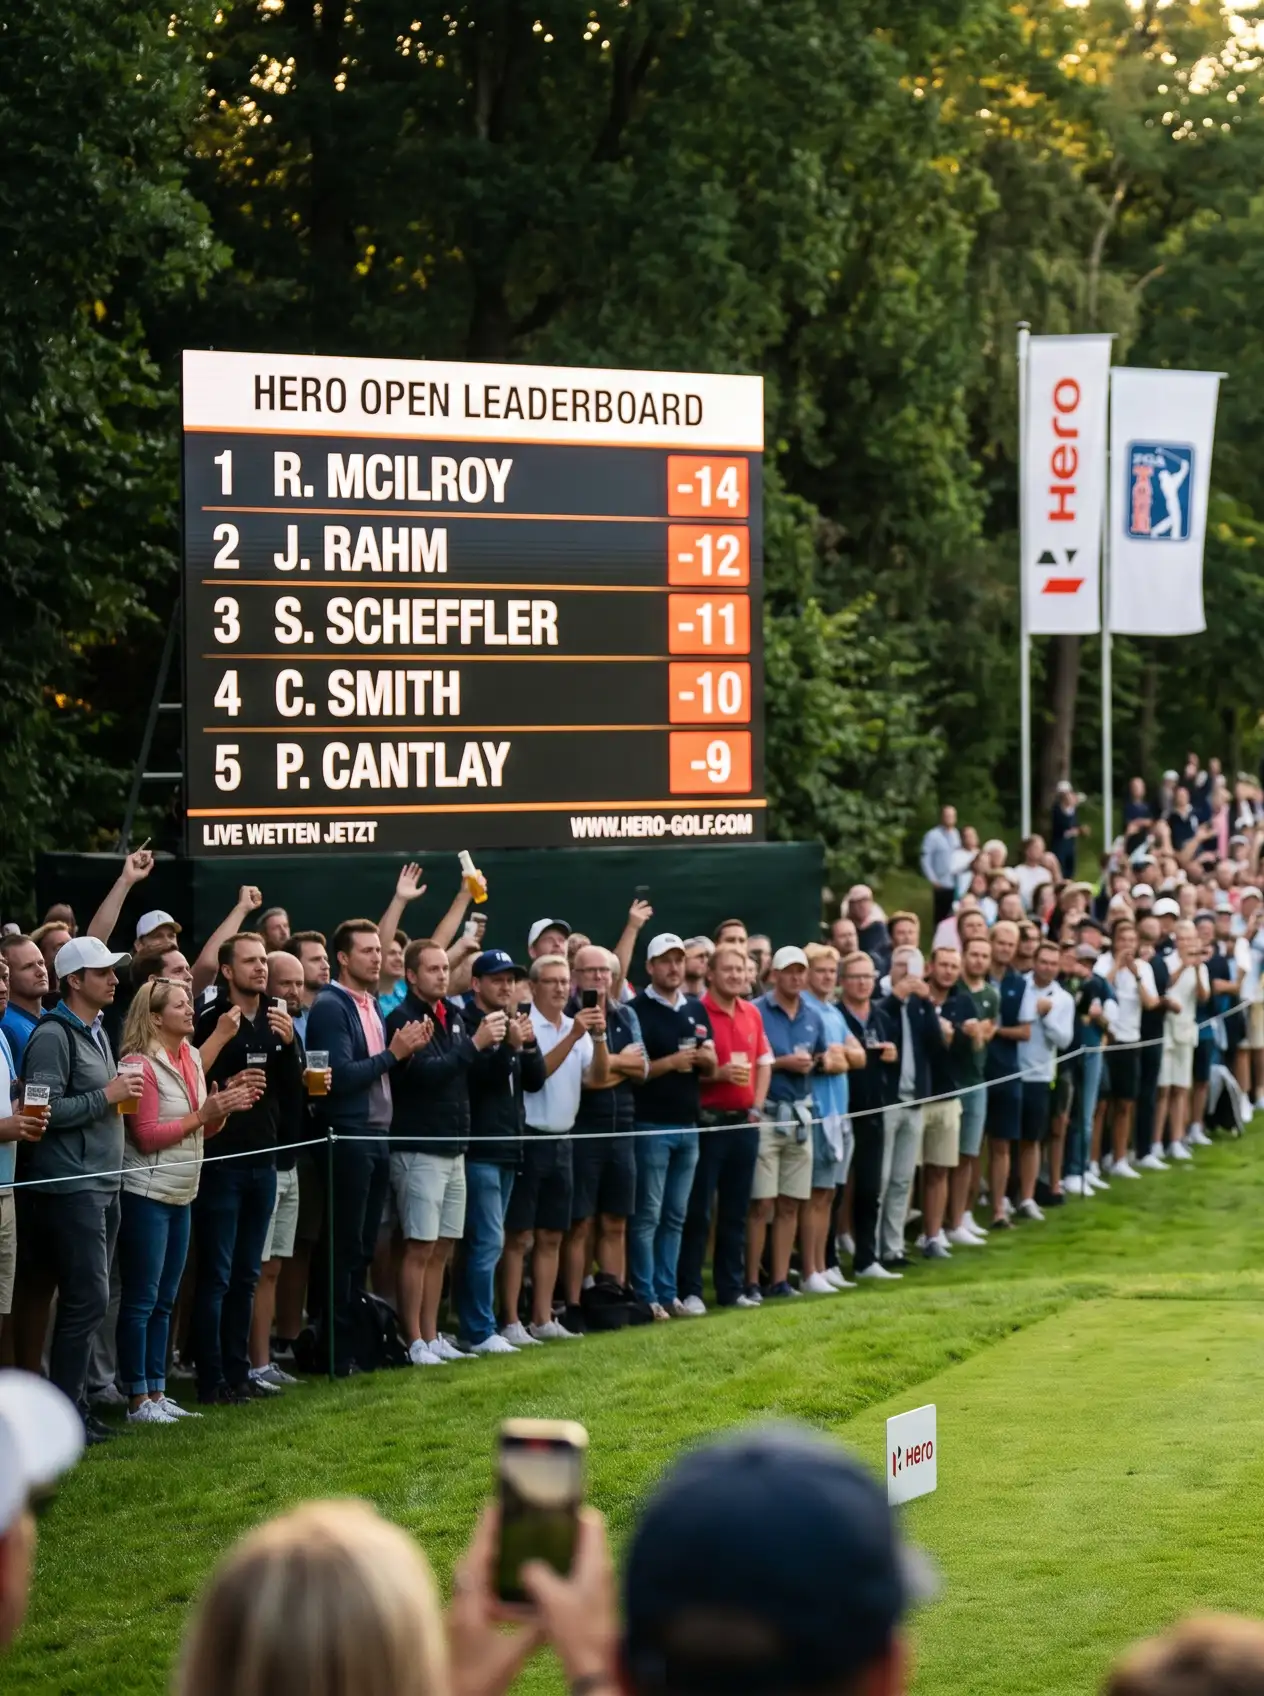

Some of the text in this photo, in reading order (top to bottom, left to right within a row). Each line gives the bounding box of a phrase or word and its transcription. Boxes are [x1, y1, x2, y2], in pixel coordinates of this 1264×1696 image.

[254, 375, 703, 426] HERO OPEN LEADERBOARD
[1048, 377, 1081, 522] Hero
[213, 450, 741, 508] 1 R. MCILROY -14
[212, 523, 742, 577] 2 J. RAHM -12
[213, 596, 736, 646] 3 S. SCHEFFLER -11
[213, 669, 743, 717] 4 C. SMITH -10
[214, 740, 732, 791] 5 P. CANTLAY -9
[203, 821, 378, 846] LIVE WETTEN JETZT
[570, 813, 753, 838] WWW.HERO-GOLF.COM
[906, 1441, 933, 1467] Hero
